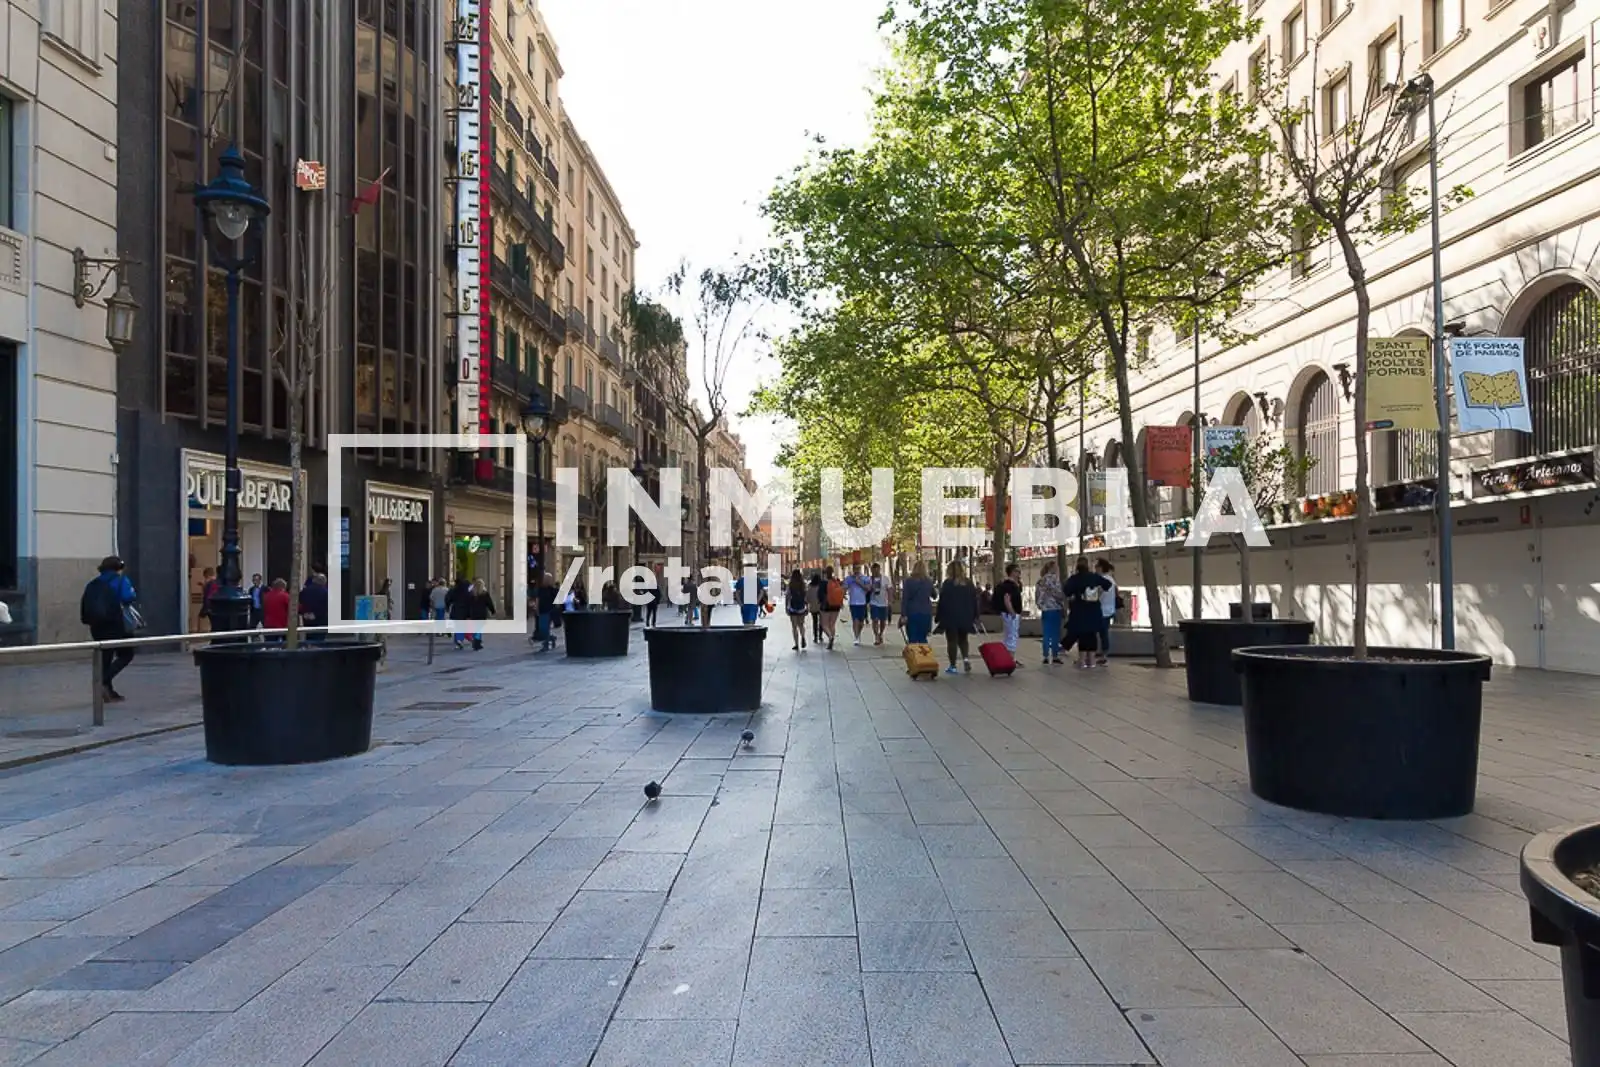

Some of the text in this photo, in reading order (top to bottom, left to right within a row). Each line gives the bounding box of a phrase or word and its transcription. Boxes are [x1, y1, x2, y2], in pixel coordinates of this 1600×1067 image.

[458, 84, 474, 107] 20
[460, 151, 474, 176] 15
[460, 220, 474, 243] 10
[463, 289, 471, 311] 5
[1375, 341, 1412, 350] SANT
[1474, 342, 1520, 350] FORMA
[463, 358, 470, 379] 0
[1367, 367, 1426, 377] FORMES
[1368, 358, 1424, 369] MOLTES
